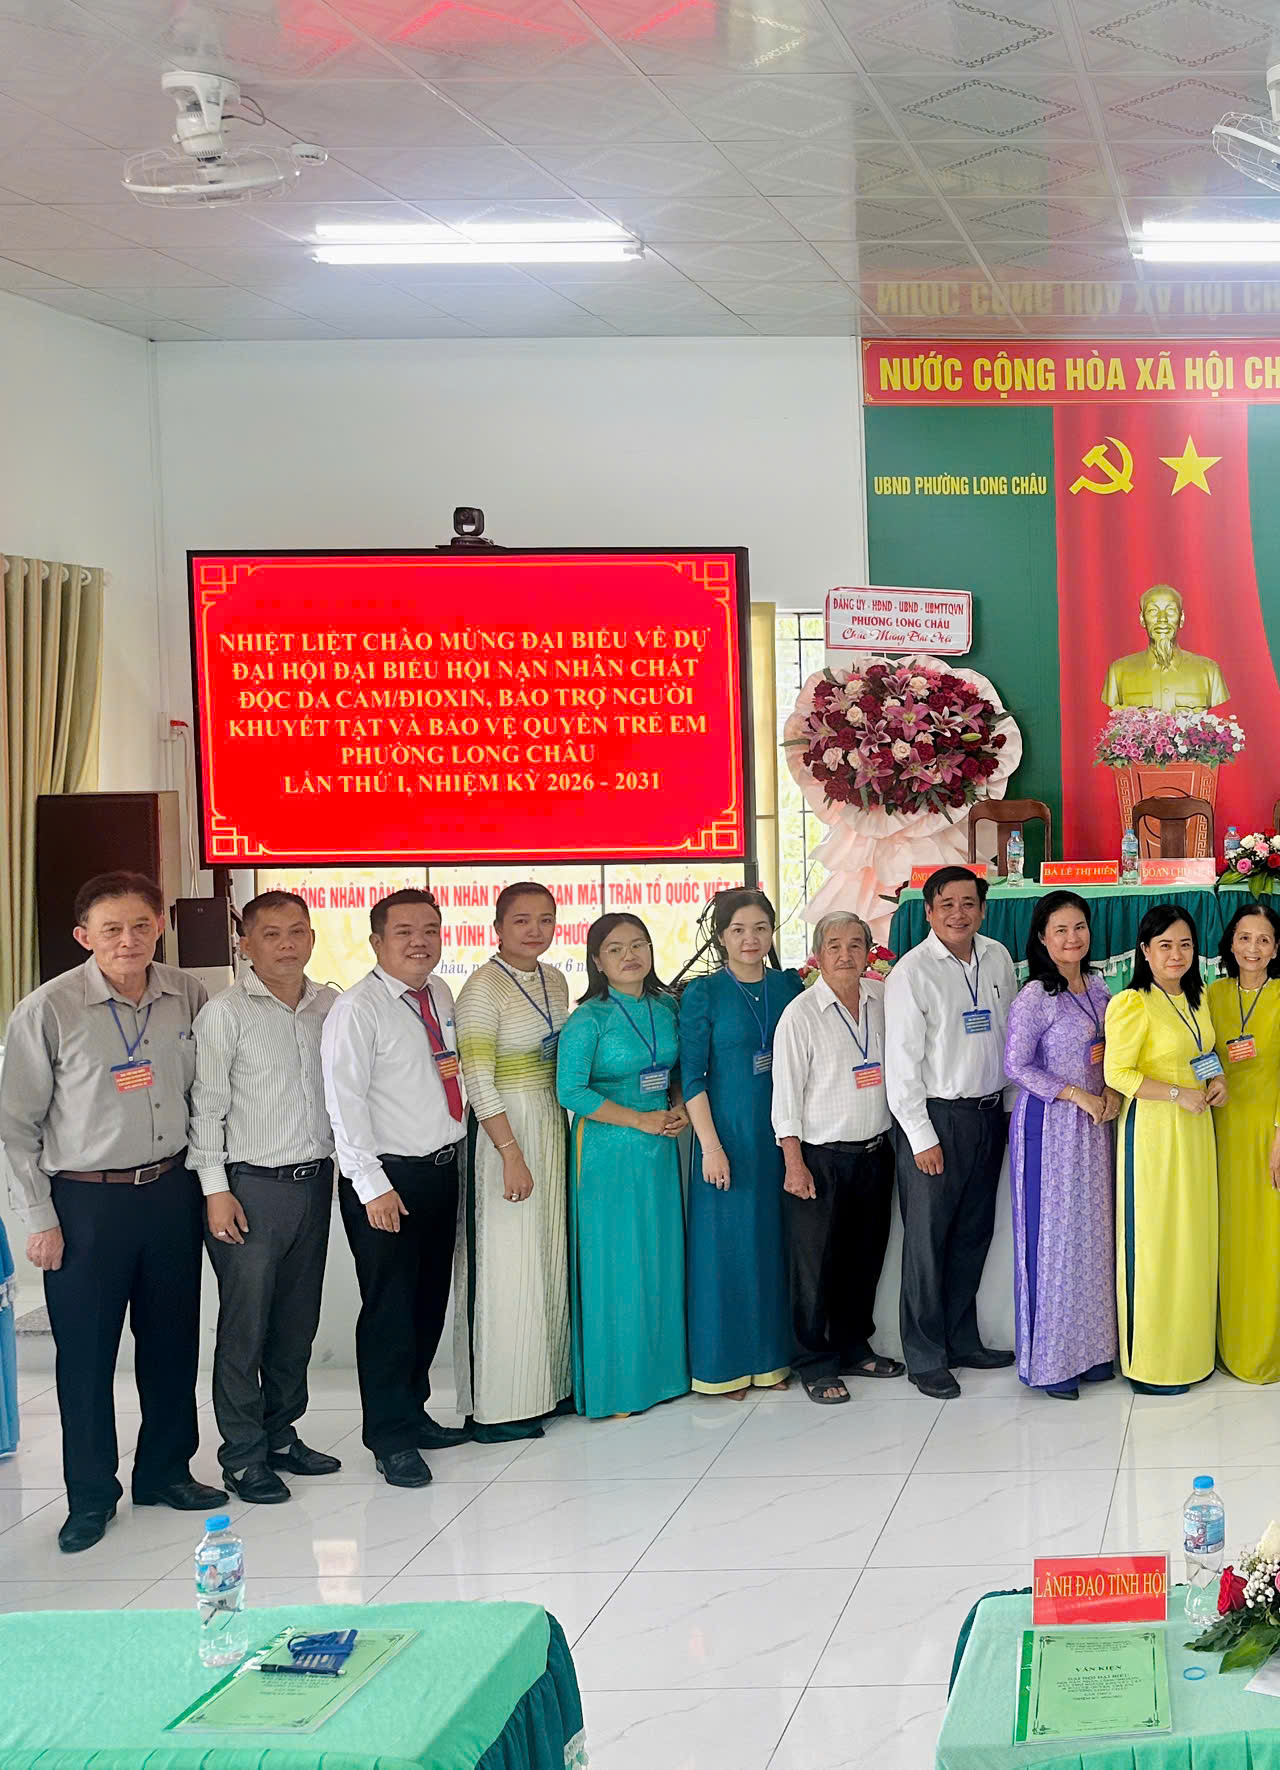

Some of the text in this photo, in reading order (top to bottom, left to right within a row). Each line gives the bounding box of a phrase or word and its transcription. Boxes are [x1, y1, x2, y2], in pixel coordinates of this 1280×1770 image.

[879, 350, 963, 392] NƯỚC
[973, 351, 1056, 399] CỘNG
[1065, 350, 1127, 391] HÒA
[1135, 350, 1176, 391] XÃ
[1184, 350, 1234, 398] HỘI
[874, 472, 1047, 495] UBND PHƯỜNG LONG CHÂU
[851, 614, 950, 630] PHƯỜNG LONG CHÂU
[219, 631, 295, 655] NHIỆT
[302, 628, 357, 655] LIỆT
[362, 627, 433, 651] CHÀO
[440, 627, 515, 650] MỪNG
[522, 631, 563, 654] ĐẠI
[634, 625, 667, 648] VỀ
[673, 627, 711, 652] DỰ
[232, 662, 274, 684] ĐẠI
[282, 660, 326, 684] HỘI
[333, 661, 375, 684] ĐẠI
[447, 659, 490, 683] HỘI
[498, 660, 548, 683] NẠN
[555, 653, 623, 677] NHÂN
[239, 688, 291, 713] ĐỘC
[298, 690, 331, 708] DA
[499, 683, 549, 707] BẢO
[554, 686, 607, 710] TRỢ
[613, 682, 694, 705] NGƯỜI
[229, 711, 707, 741] KHUYẾT TẬT VÀ BẢO VỆ QUYỀN TRẺ EM
[341, 739, 595, 765] PHƯỜNG LONG CHÂU
[284, 769, 331, 793] LẦN
[338, 769, 392, 793] THỨ
[398, 775, 413, 796] I,
[418, 772, 499, 796] NHIỆM
[507, 769, 540, 792] KỲ
[547, 773, 595, 791] 2026
[615, 772, 660, 790] 2031
[330, 881, 365, 908] NHÂN
[427, 885, 449, 907] AN
[454, 880, 488, 907] NHÂN
[609, 879, 642, 910] TRẬN
[646, 874, 661, 905] TỔ
[666, 874, 700, 906] QUỐC
[456, 920, 485, 946] VĨNH
[565, 958, 573, 973] 6
[1035, 1567, 1166, 1600] LÃNH ĐẠO TỈNH HỘI
